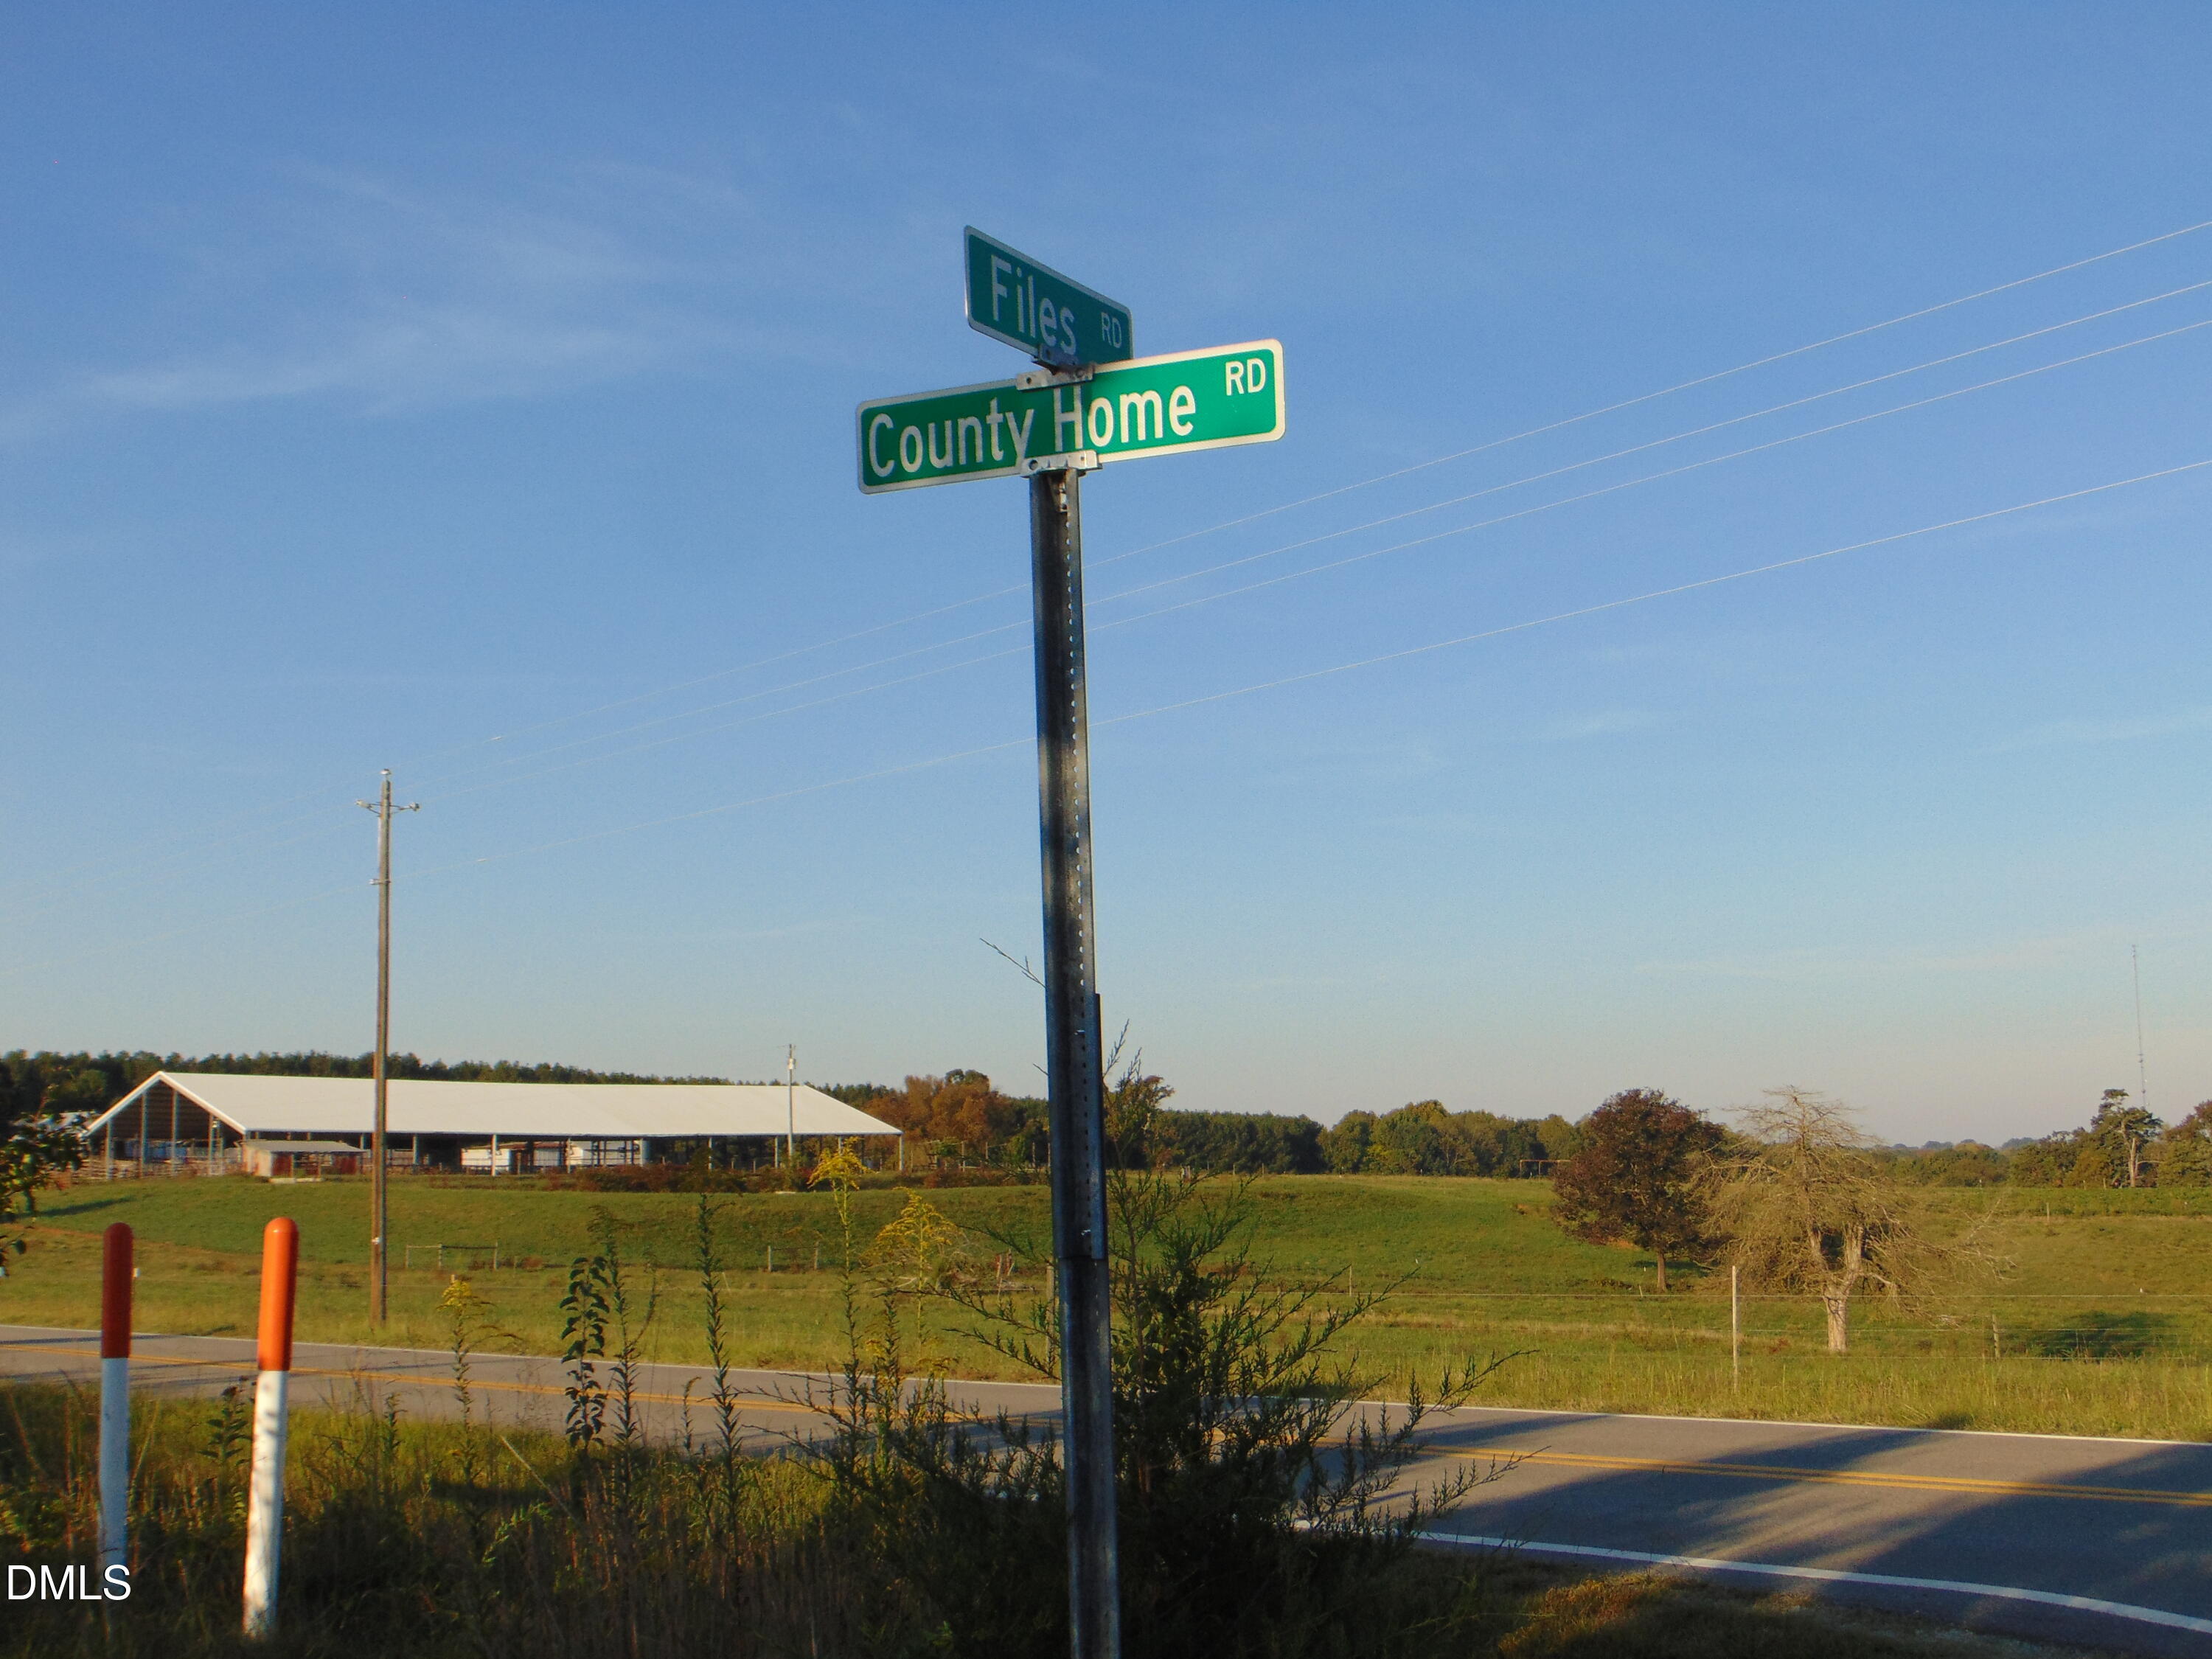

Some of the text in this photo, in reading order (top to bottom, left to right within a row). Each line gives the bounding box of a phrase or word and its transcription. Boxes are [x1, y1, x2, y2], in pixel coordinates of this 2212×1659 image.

[990, 254, 1122, 355] Files RD
[869, 358, 1266, 478] County Home RD
